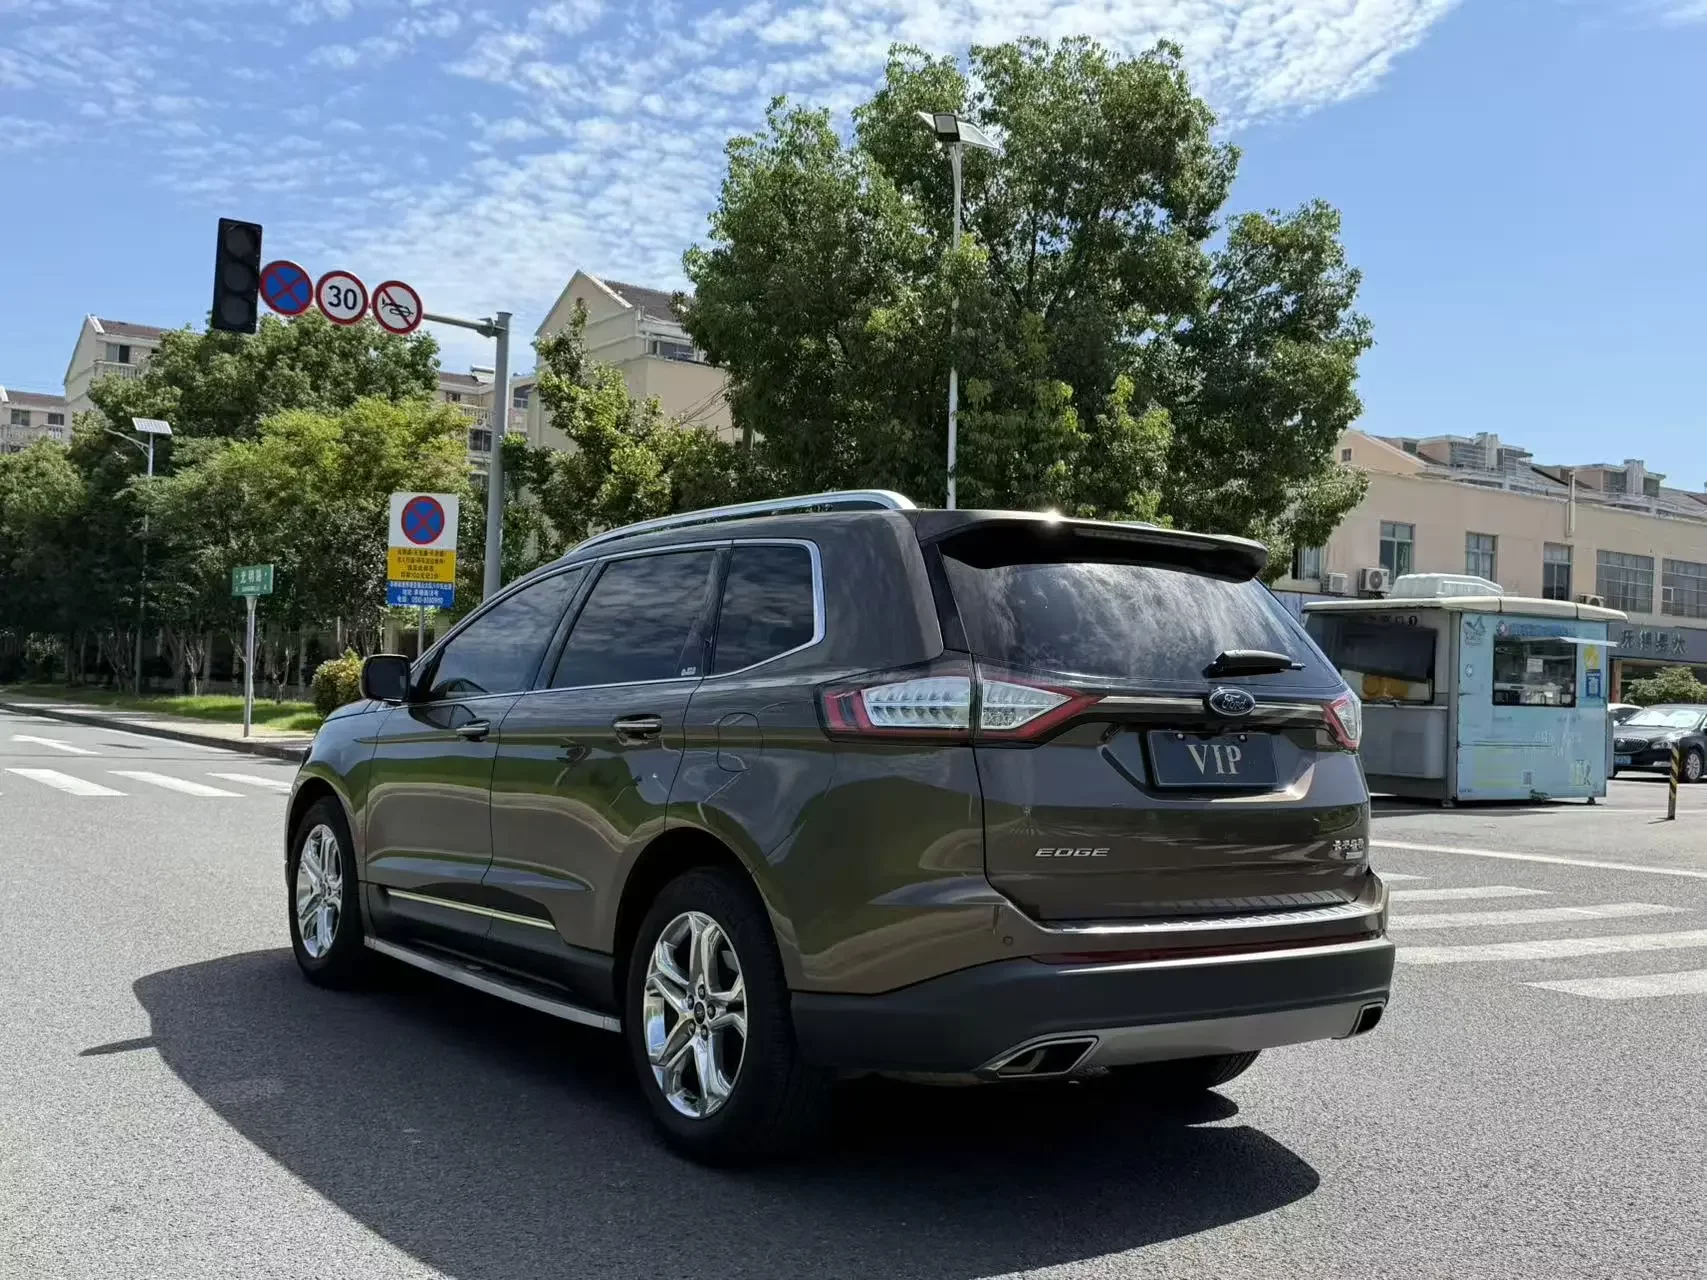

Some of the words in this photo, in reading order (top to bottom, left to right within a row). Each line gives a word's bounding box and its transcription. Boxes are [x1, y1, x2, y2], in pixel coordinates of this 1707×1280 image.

[328, 285, 358, 311] 30
[1221, 693, 1247, 710] Ford
[1187, 744, 1242, 775] VIP
[1035, 847, 1110, 857] EDGE
